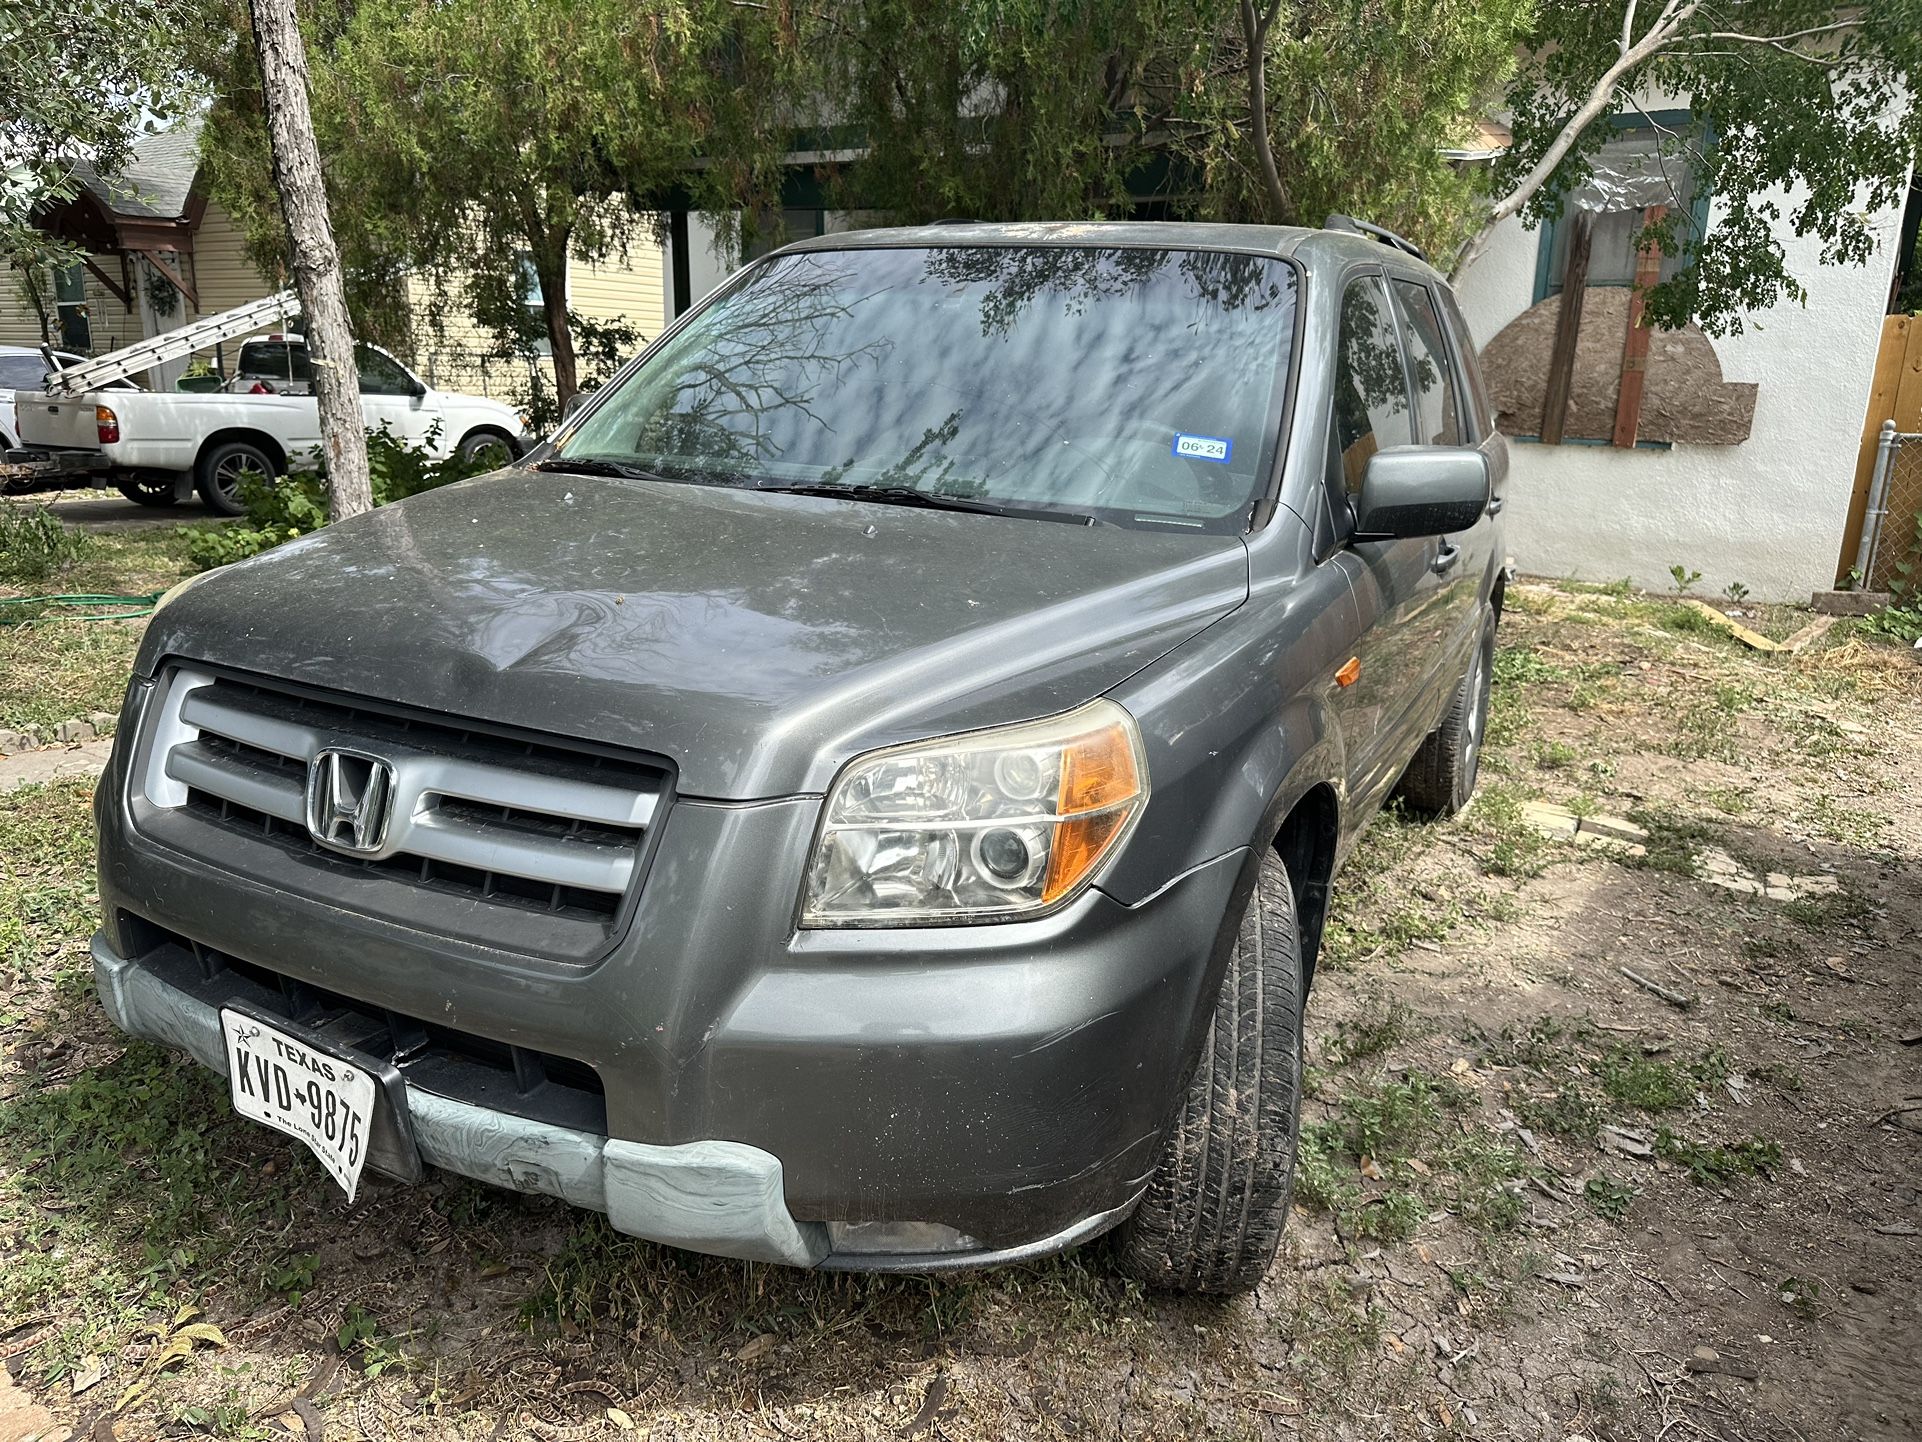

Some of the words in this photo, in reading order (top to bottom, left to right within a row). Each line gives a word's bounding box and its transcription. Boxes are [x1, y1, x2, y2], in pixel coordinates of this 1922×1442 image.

[272, 1037, 336, 1082] TEXAS
[277, 1115, 292, 1127] The
[294, 1123, 310, 1138] Lone
[311, 1134, 321, 1149] Star
